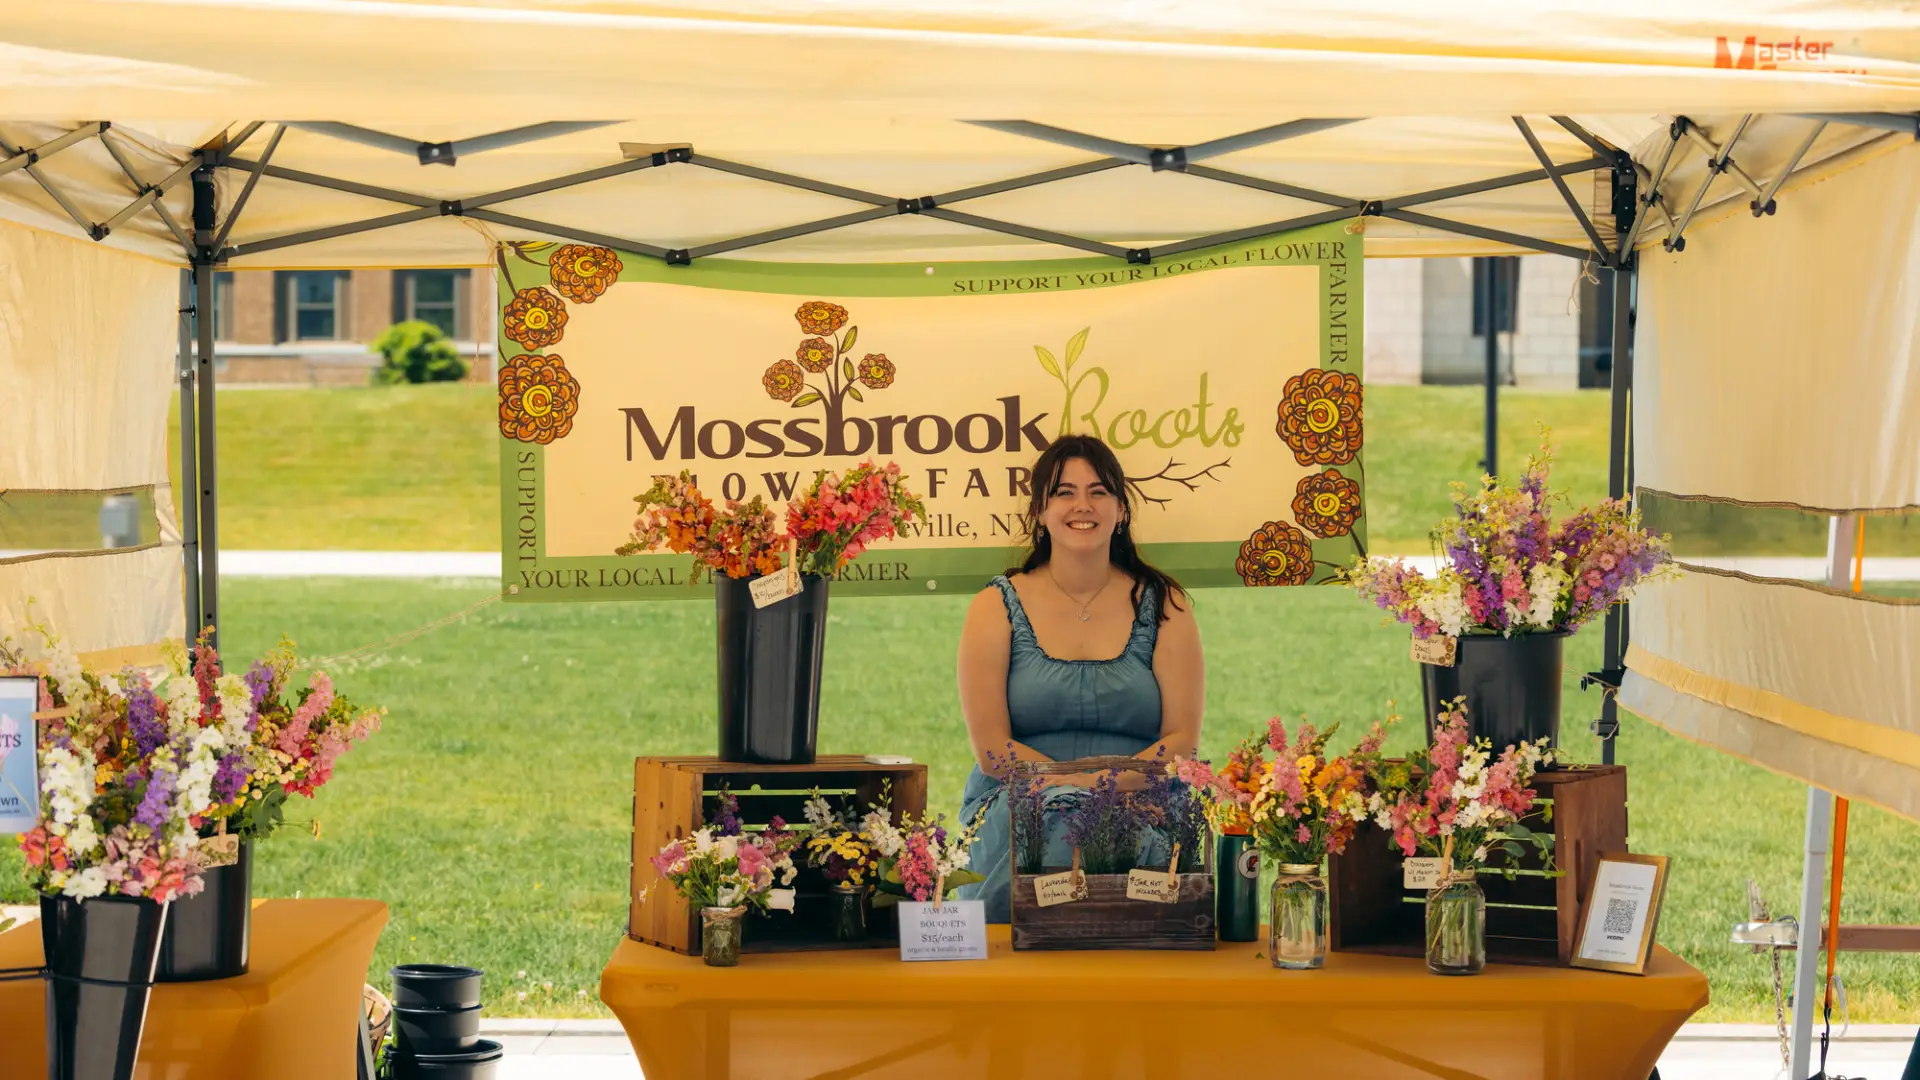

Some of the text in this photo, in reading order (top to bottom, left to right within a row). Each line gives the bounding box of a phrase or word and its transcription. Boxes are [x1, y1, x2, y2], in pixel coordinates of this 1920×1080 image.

[1714, 36, 1834, 69] Master
[953, 241, 1347, 293] SUPPORT YOUR LOCAL FLOWER
[1329, 261, 1348, 364] FARMER
[618, 366, 1245, 461] Mossbrook Roots
[925, 467, 1033, 498] FAR
[517, 451, 537, 567] SUPPORT
[897, 513, 1033, 540] eville, NY
[520, 569, 590, 588] YOUR
[598, 567, 683, 587] LOCAL
[829, 562, 911, 583] RMER
[920, 920, 967, 928] BOUQUETS
[921, 906, 959, 915] JAM JAR
[921, 932, 964, 943] $15/each
